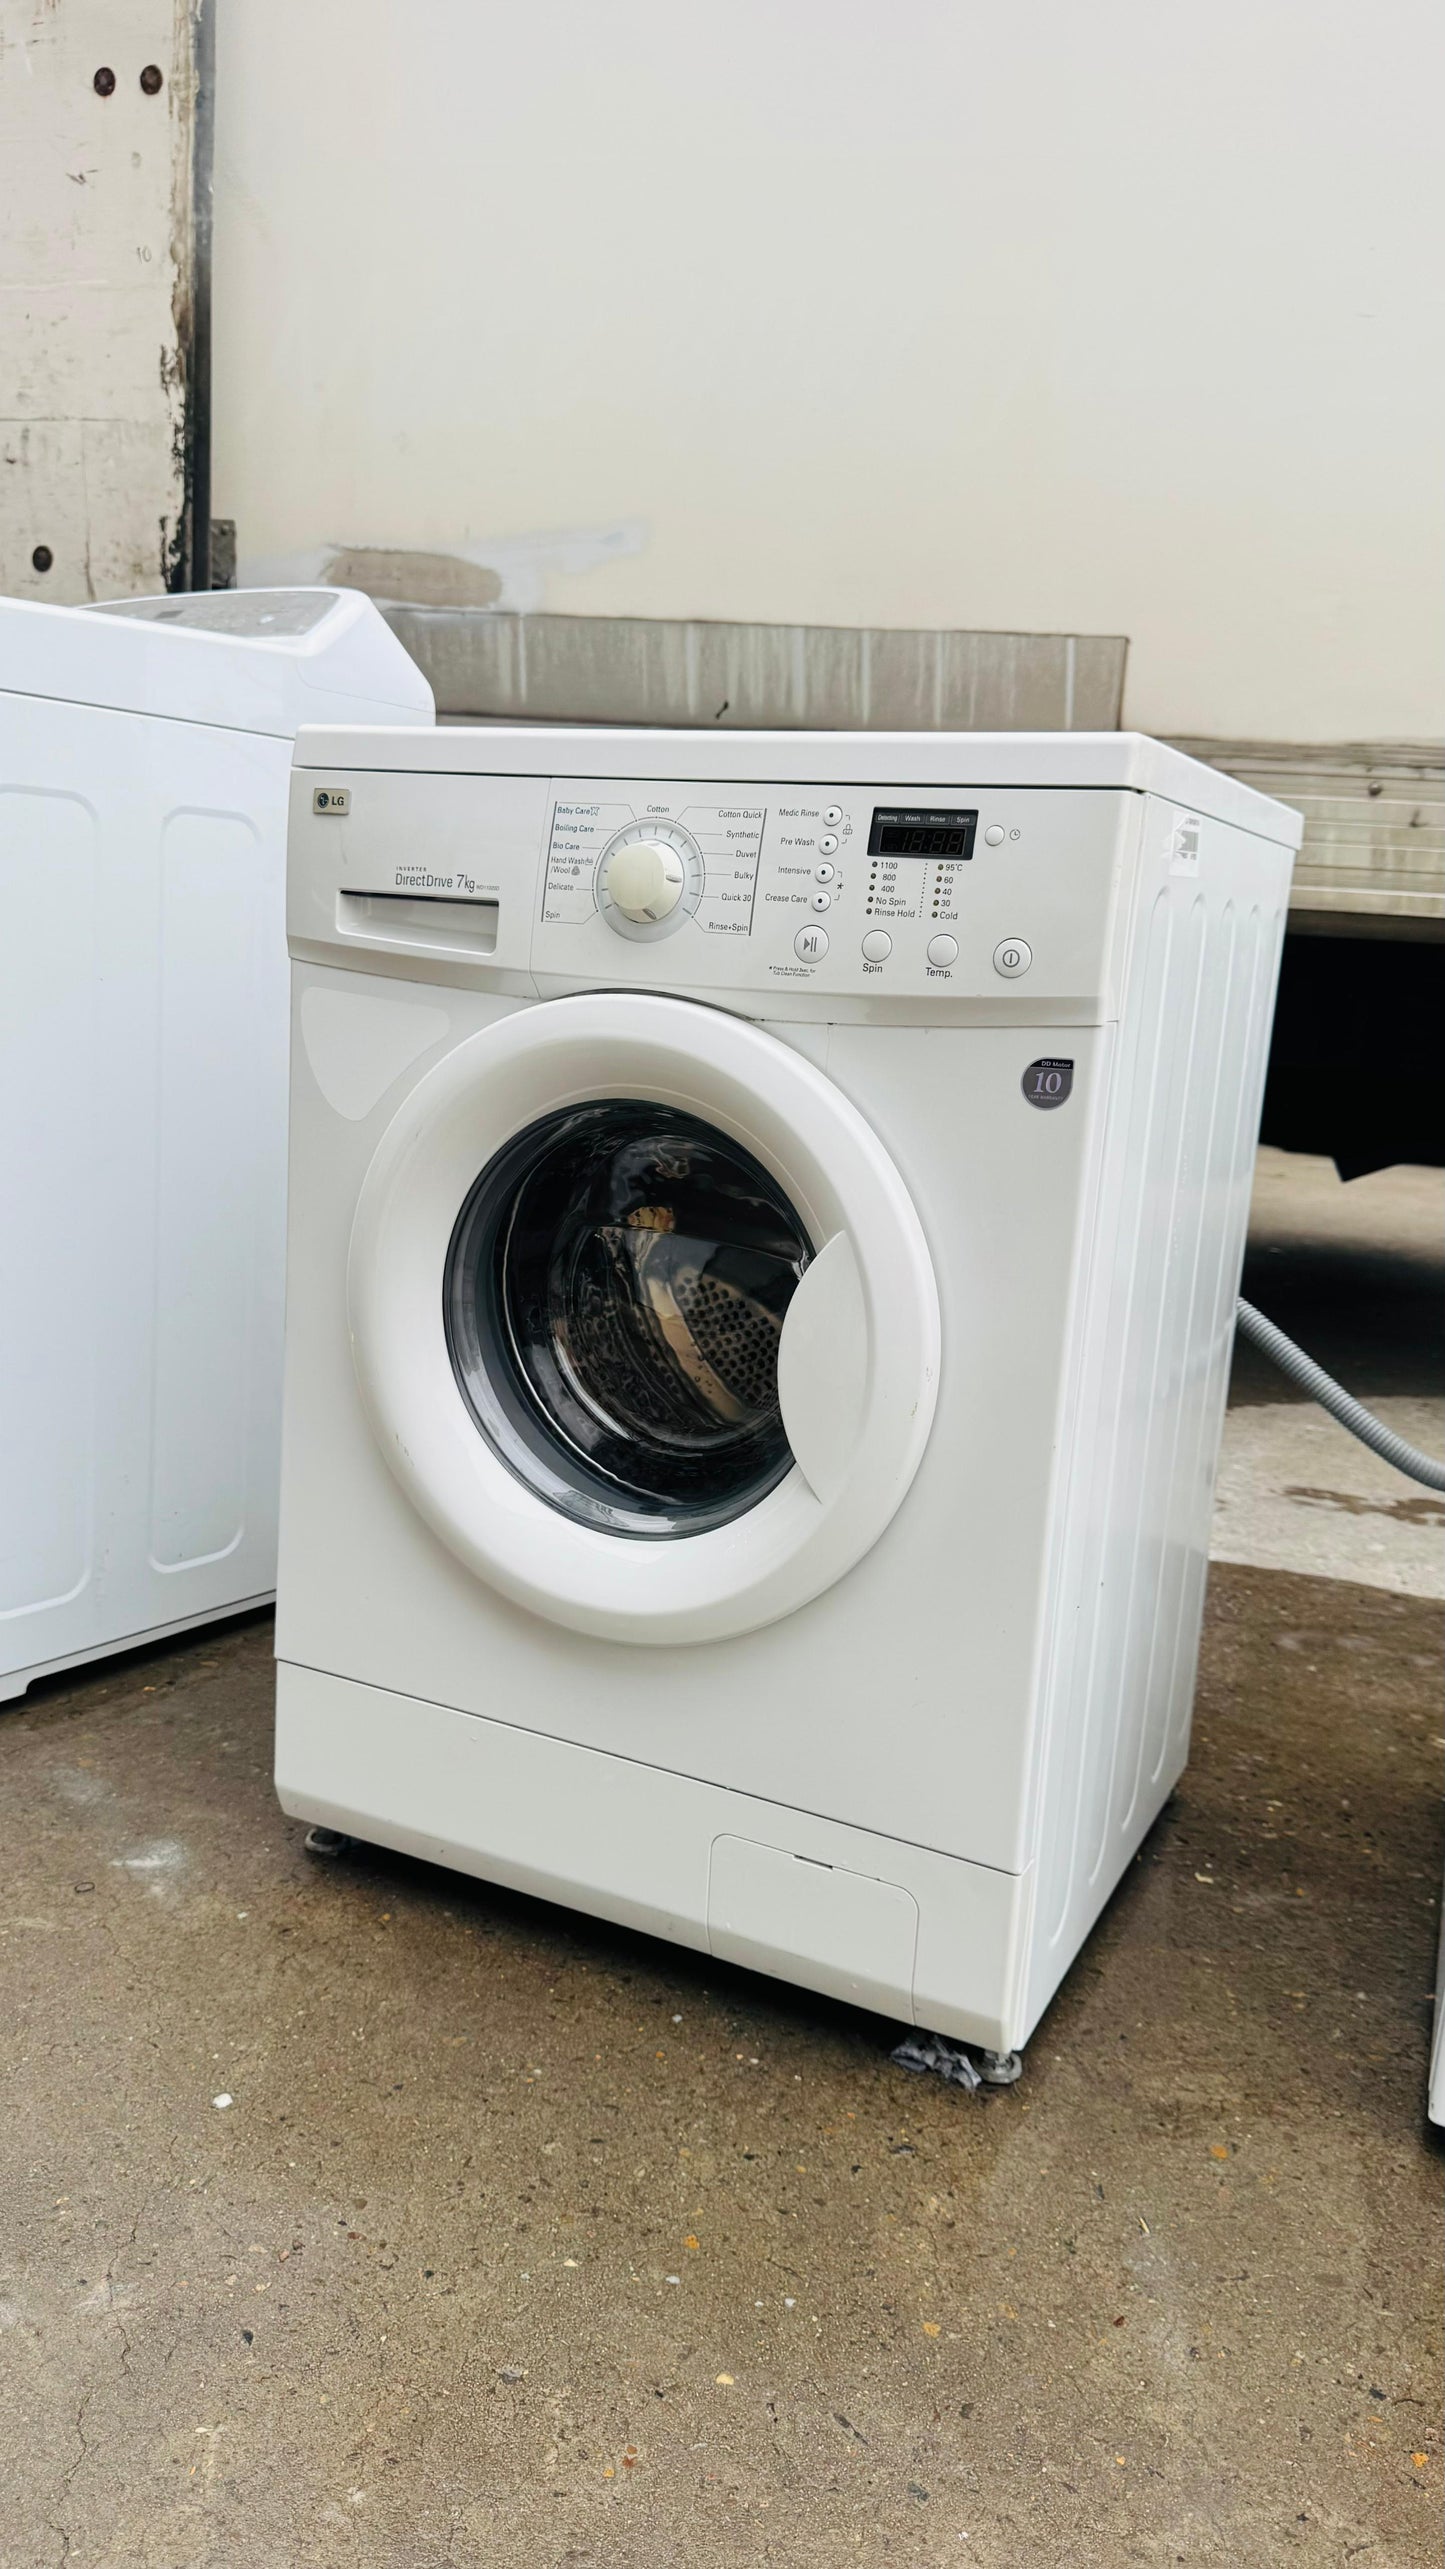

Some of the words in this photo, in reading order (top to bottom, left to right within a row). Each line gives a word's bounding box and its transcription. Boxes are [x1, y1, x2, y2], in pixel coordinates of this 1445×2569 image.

[332, 796, 344, 806] LG
[557, 807, 573, 816] Baby
[647, 805, 669, 813] Cotton
[800, 809, 819, 817] Rinse
[718, 810, 740, 818] Cotton
[743, 811, 762, 819] Quick
[555, 824, 577, 833] Boiling
[726, 830, 759, 839] Synthetic
[780, 837, 792, 845] Pre
[795, 838, 815, 846] Wash
[736, 850, 757, 858] Duvet
[550, 866, 570, 874] /Wool
[778, 866, 811, 875] Intensive
[734, 872, 754, 880] Bulky
[457, 874, 475, 893] 7kg
[548, 882, 574, 891] Delicate
[721, 893, 740, 901] Quick
[743, 894, 751, 902] 30
[765, 893, 789, 902] Crease
[791, 895, 807, 903] Care
[876, 897, 887, 905] No
[889, 898, 906, 906] Spin
[545, 911, 560, 919] Spin
[874, 908, 895, 916] Rinse
[897, 910, 915, 918] Hold
[940, 912, 958, 920] Cold
[709, 922, 748, 931] Rinse+Spin
[862, 963, 883, 973] Spin
[925, 967, 952, 978] Temp.
[1034, 1072, 1062, 1093] 10
